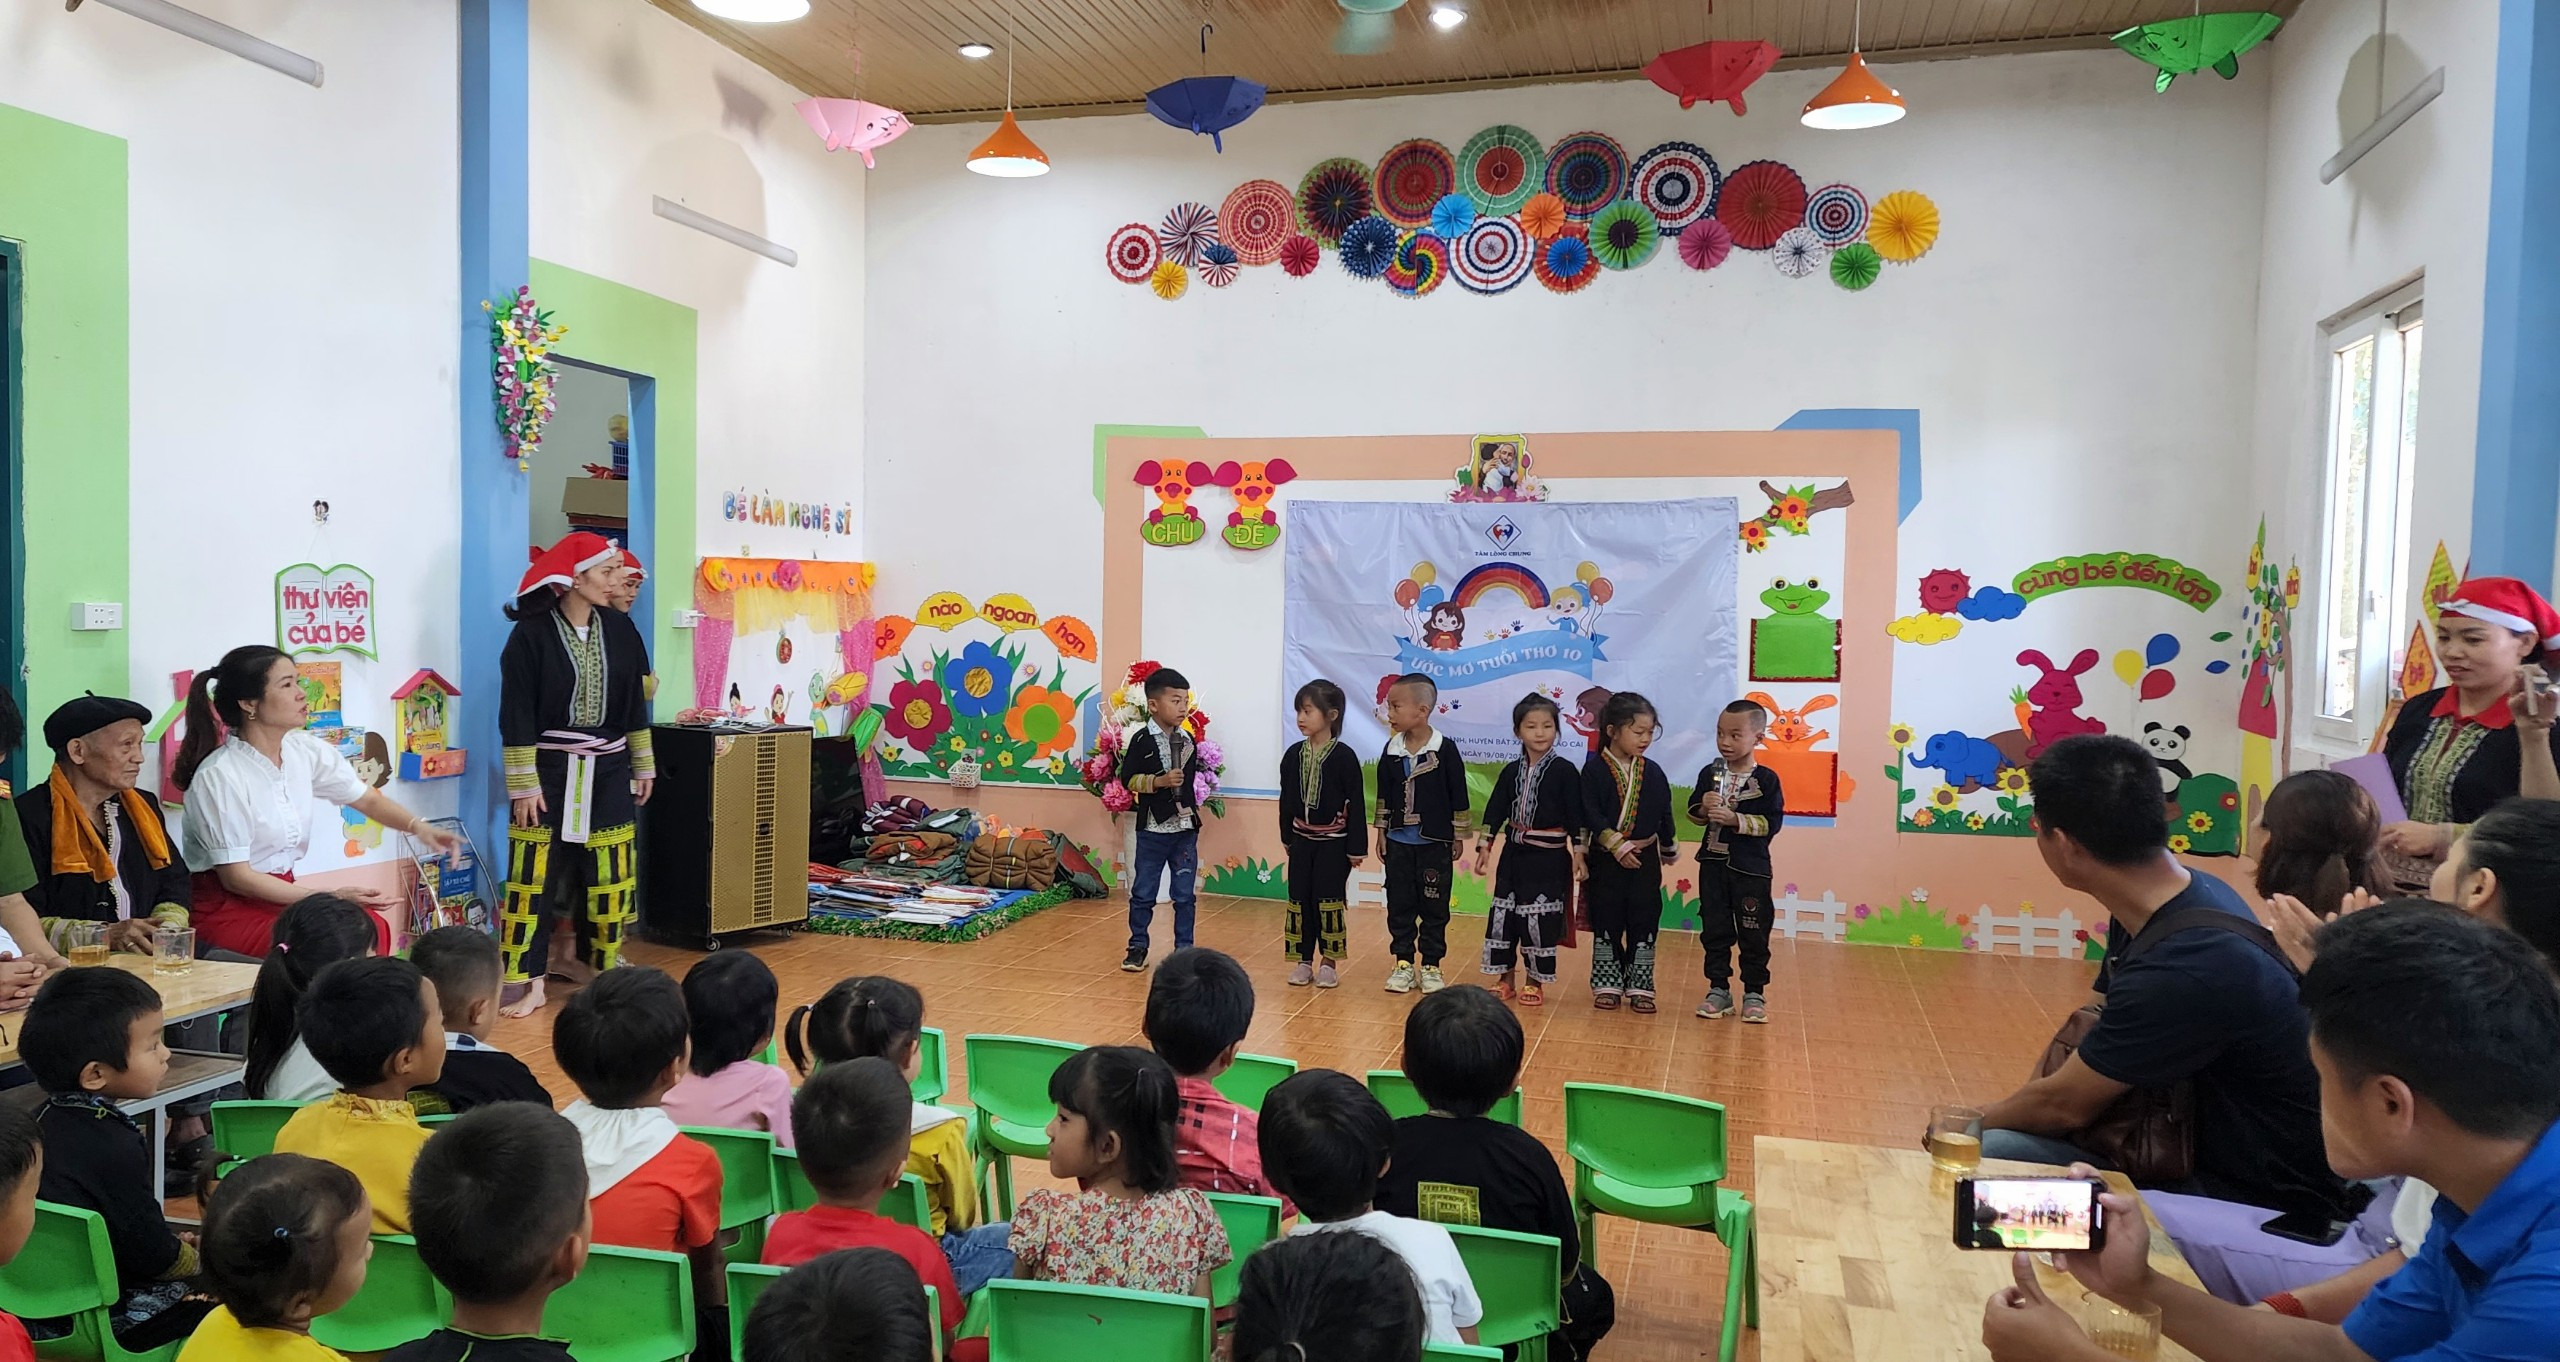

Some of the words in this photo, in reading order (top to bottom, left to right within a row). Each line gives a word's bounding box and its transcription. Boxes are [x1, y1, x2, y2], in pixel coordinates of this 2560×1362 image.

[723, 486, 748, 522] BÉ
[750, 488, 786, 527] LÀM
[1152, 512, 1195, 543] CHỦ
[283, 585, 320, 610] thư
[323, 582, 368, 615] viện
[2019, 567, 2079, 594] cùng
[2083, 560, 2118, 580] bé
[2121, 560, 2170, 587] đến
[2173, 573, 2212, 604] lớp
[287, 611, 333, 645] của
[335, 614, 366, 644] bé
[929, 599, 963, 618] nào
[983, 602, 1037, 626] ngoan
[1448, 661, 1475, 678] MƠ
[1477, 646, 1518, 672] TUỔI
[1521, 644, 1557, 660] THƠ
[1563, 648, 1582, 661] 10
